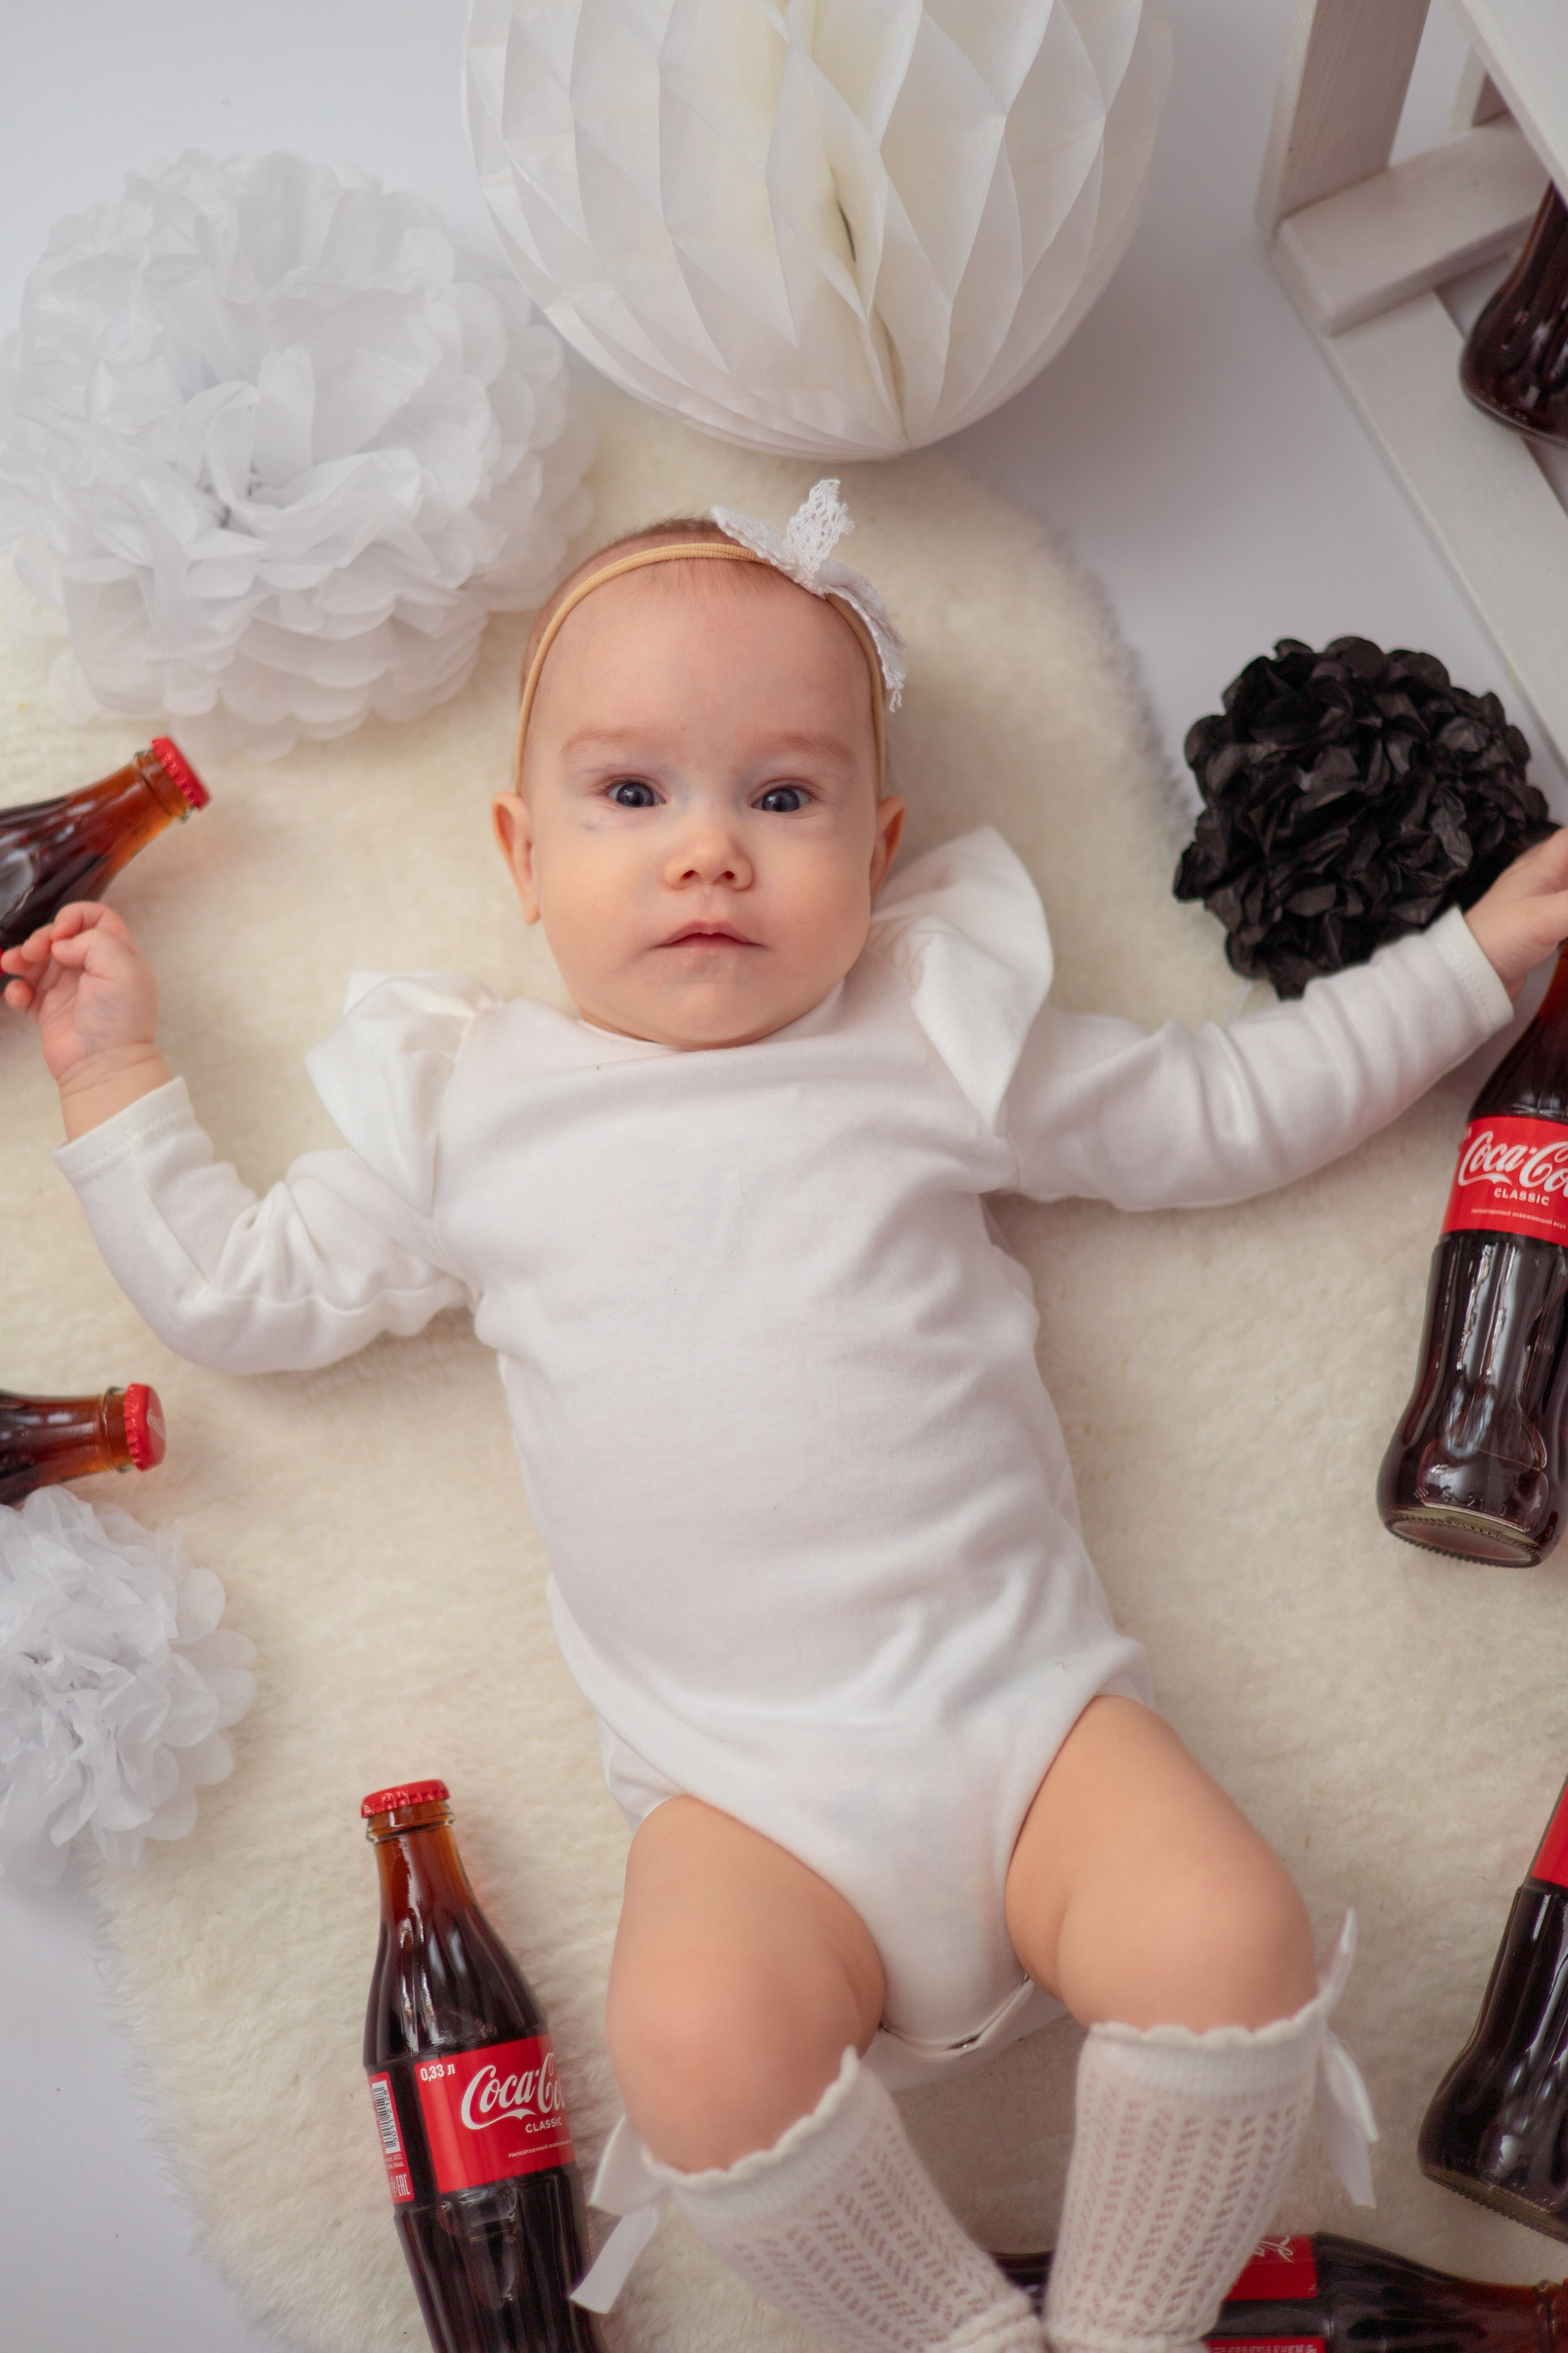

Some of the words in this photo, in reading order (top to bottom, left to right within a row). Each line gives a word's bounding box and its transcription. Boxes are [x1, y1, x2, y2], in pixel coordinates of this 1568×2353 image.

[1458, 1130, 1568, 1198] Coca-Co
[1493, 1187, 1550, 1206] CLASSIC
[420, 2064, 445, 2082] 0,33
[447, 2063, 456, 2075] л
[461, 2052, 565, 2130] Coca-Co
[525, 2117, 563, 2133] CLASSIC
[508, 2144, 549, 2158] Неповторимый
